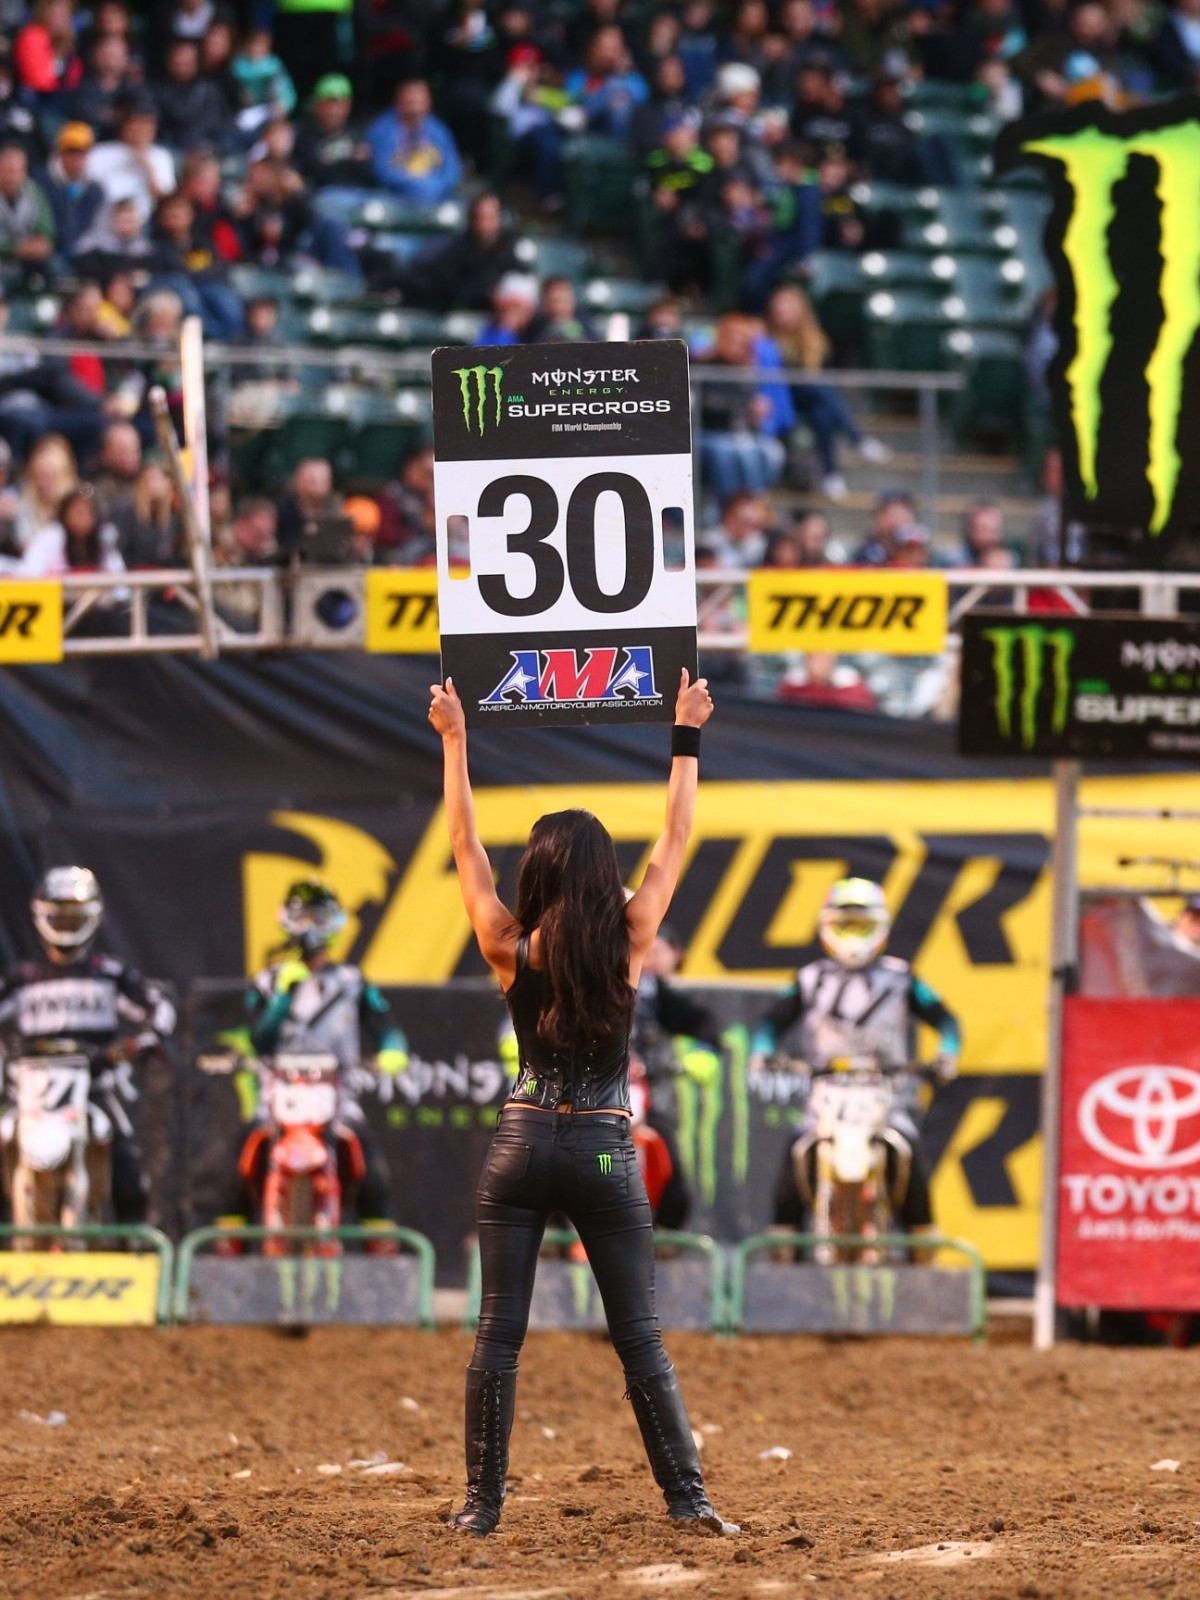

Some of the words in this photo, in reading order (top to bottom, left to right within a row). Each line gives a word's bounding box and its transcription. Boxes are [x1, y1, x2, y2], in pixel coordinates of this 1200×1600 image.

[531, 368, 640, 386] MONSTER
[549, 387, 624, 396] ENERGY
[508, 400, 671, 418] SUPERCROSS
[564, 423, 582, 431] World
[583, 422, 622, 432] Championship
[476, 471, 654, 617] 30
[768, 594, 926, 630] THOR
[478, 646, 663, 704] AMA
[478, 703, 528, 712] AMERICAN
[529, 701, 601, 710] MOTORCYCLIST
[602, 699, 663, 708] ASSOCIATION
